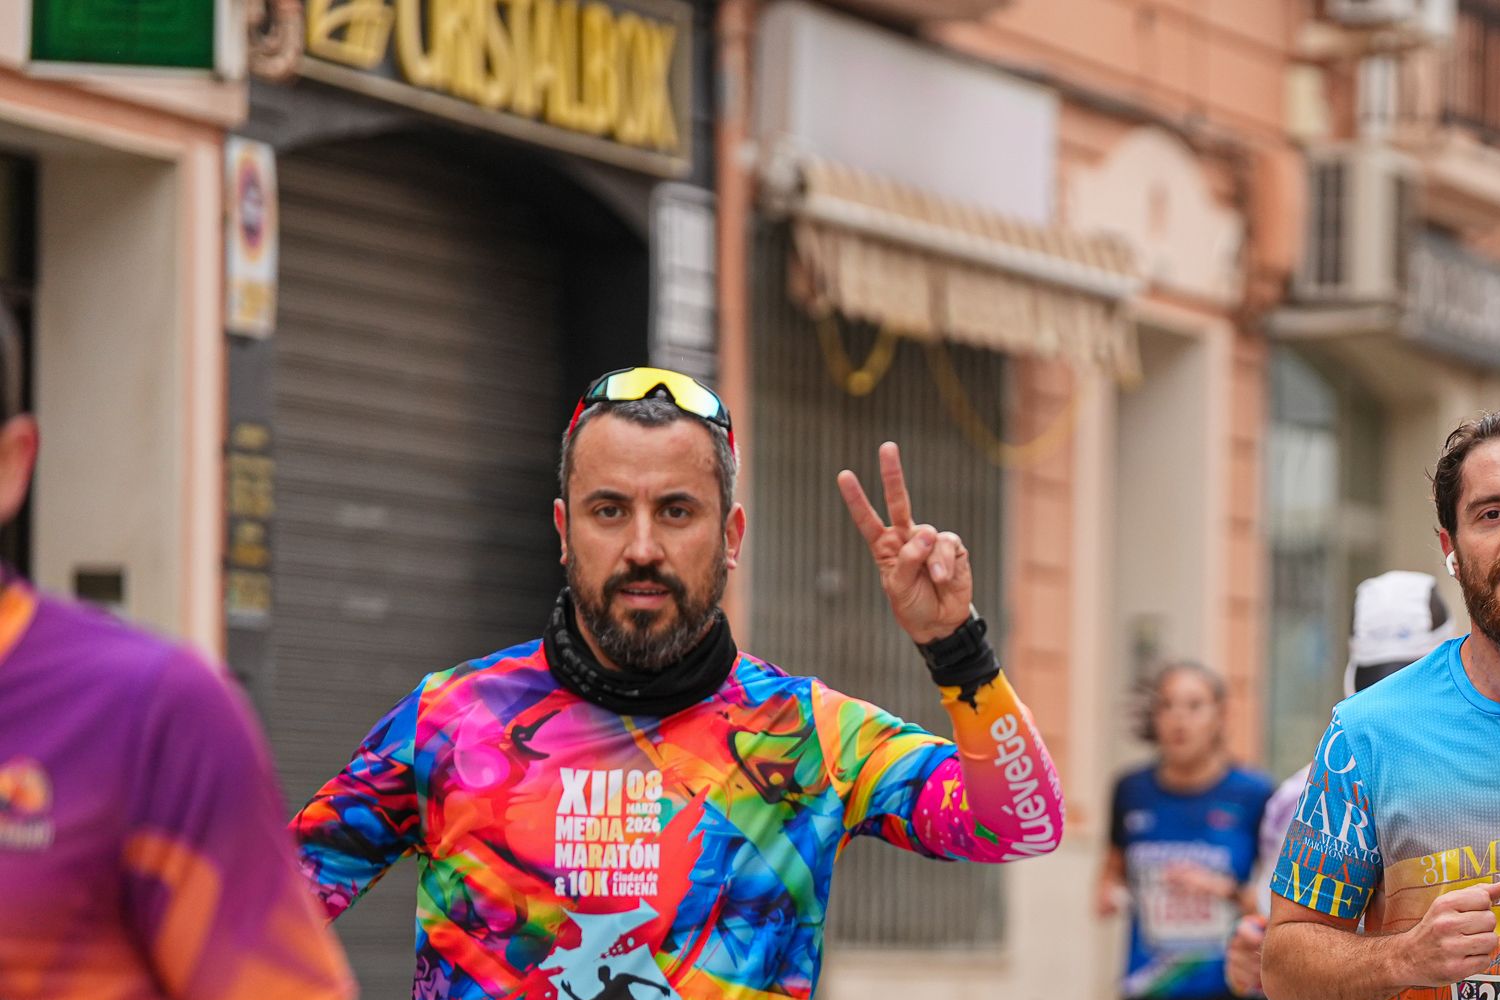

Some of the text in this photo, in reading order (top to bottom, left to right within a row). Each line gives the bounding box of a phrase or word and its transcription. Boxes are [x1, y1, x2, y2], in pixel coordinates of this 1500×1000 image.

[556, 767, 624, 816] XII
[626, 769, 663, 801] 08
[626, 802, 662, 814] MARZO
[556, 816, 625, 842] MEDIA
[626, 816, 661, 833] 2026
[554, 837, 660, 869] MARATÓN
[554, 870, 609, 897] & 10K
[612, 871, 658, 881] Ciudad de
[612, 881, 658, 896] LUCENA
